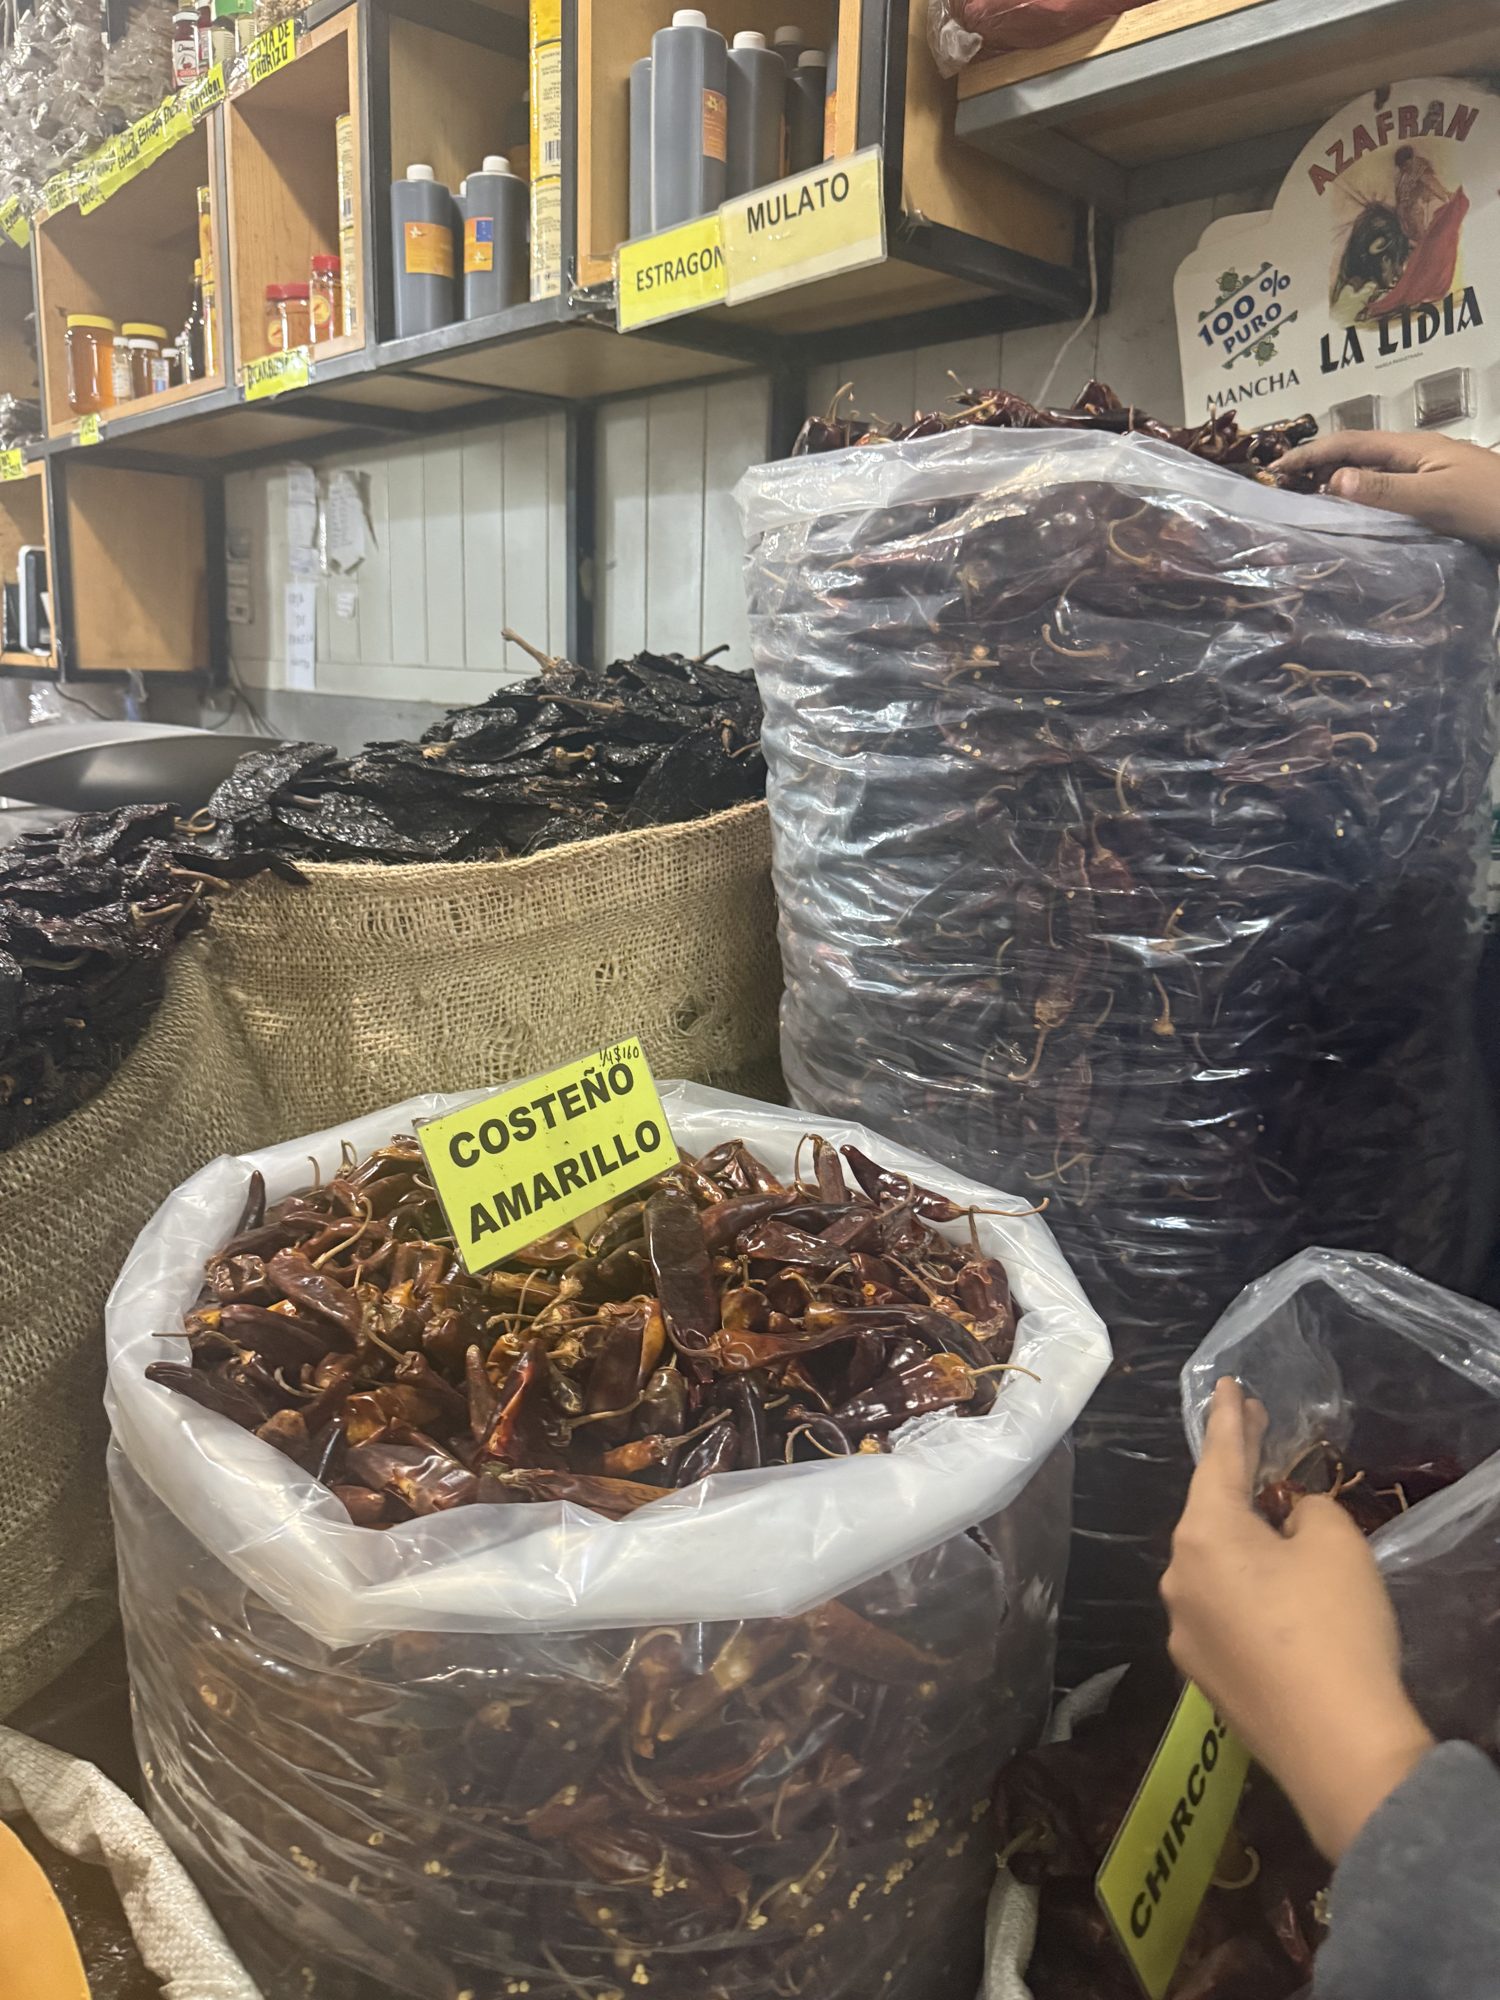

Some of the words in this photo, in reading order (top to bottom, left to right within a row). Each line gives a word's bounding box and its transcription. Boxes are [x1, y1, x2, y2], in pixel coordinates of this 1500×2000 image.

[250, 41, 288, 83] CHORIZO
[277, 21, 290, 44] DE
[1307, 100, 1480, 197] AZAFRAN
[747, 172, 849, 234] MULATO
[1197, 295, 1255, 347] 100
[1259, 269, 1291, 298] %
[1223, 302, 1282, 354] PURO
[1319, 325, 1365, 375] LA
[1378, 286, 1484, 357] LIDIA
[1206, 369, 1300, 411] MANCHA
[613, 1045, 639, 1063] $160
[449, 1063, 634, 1168] COSTEÑO
[471, 1120, 661, 1244] AMARILLO
